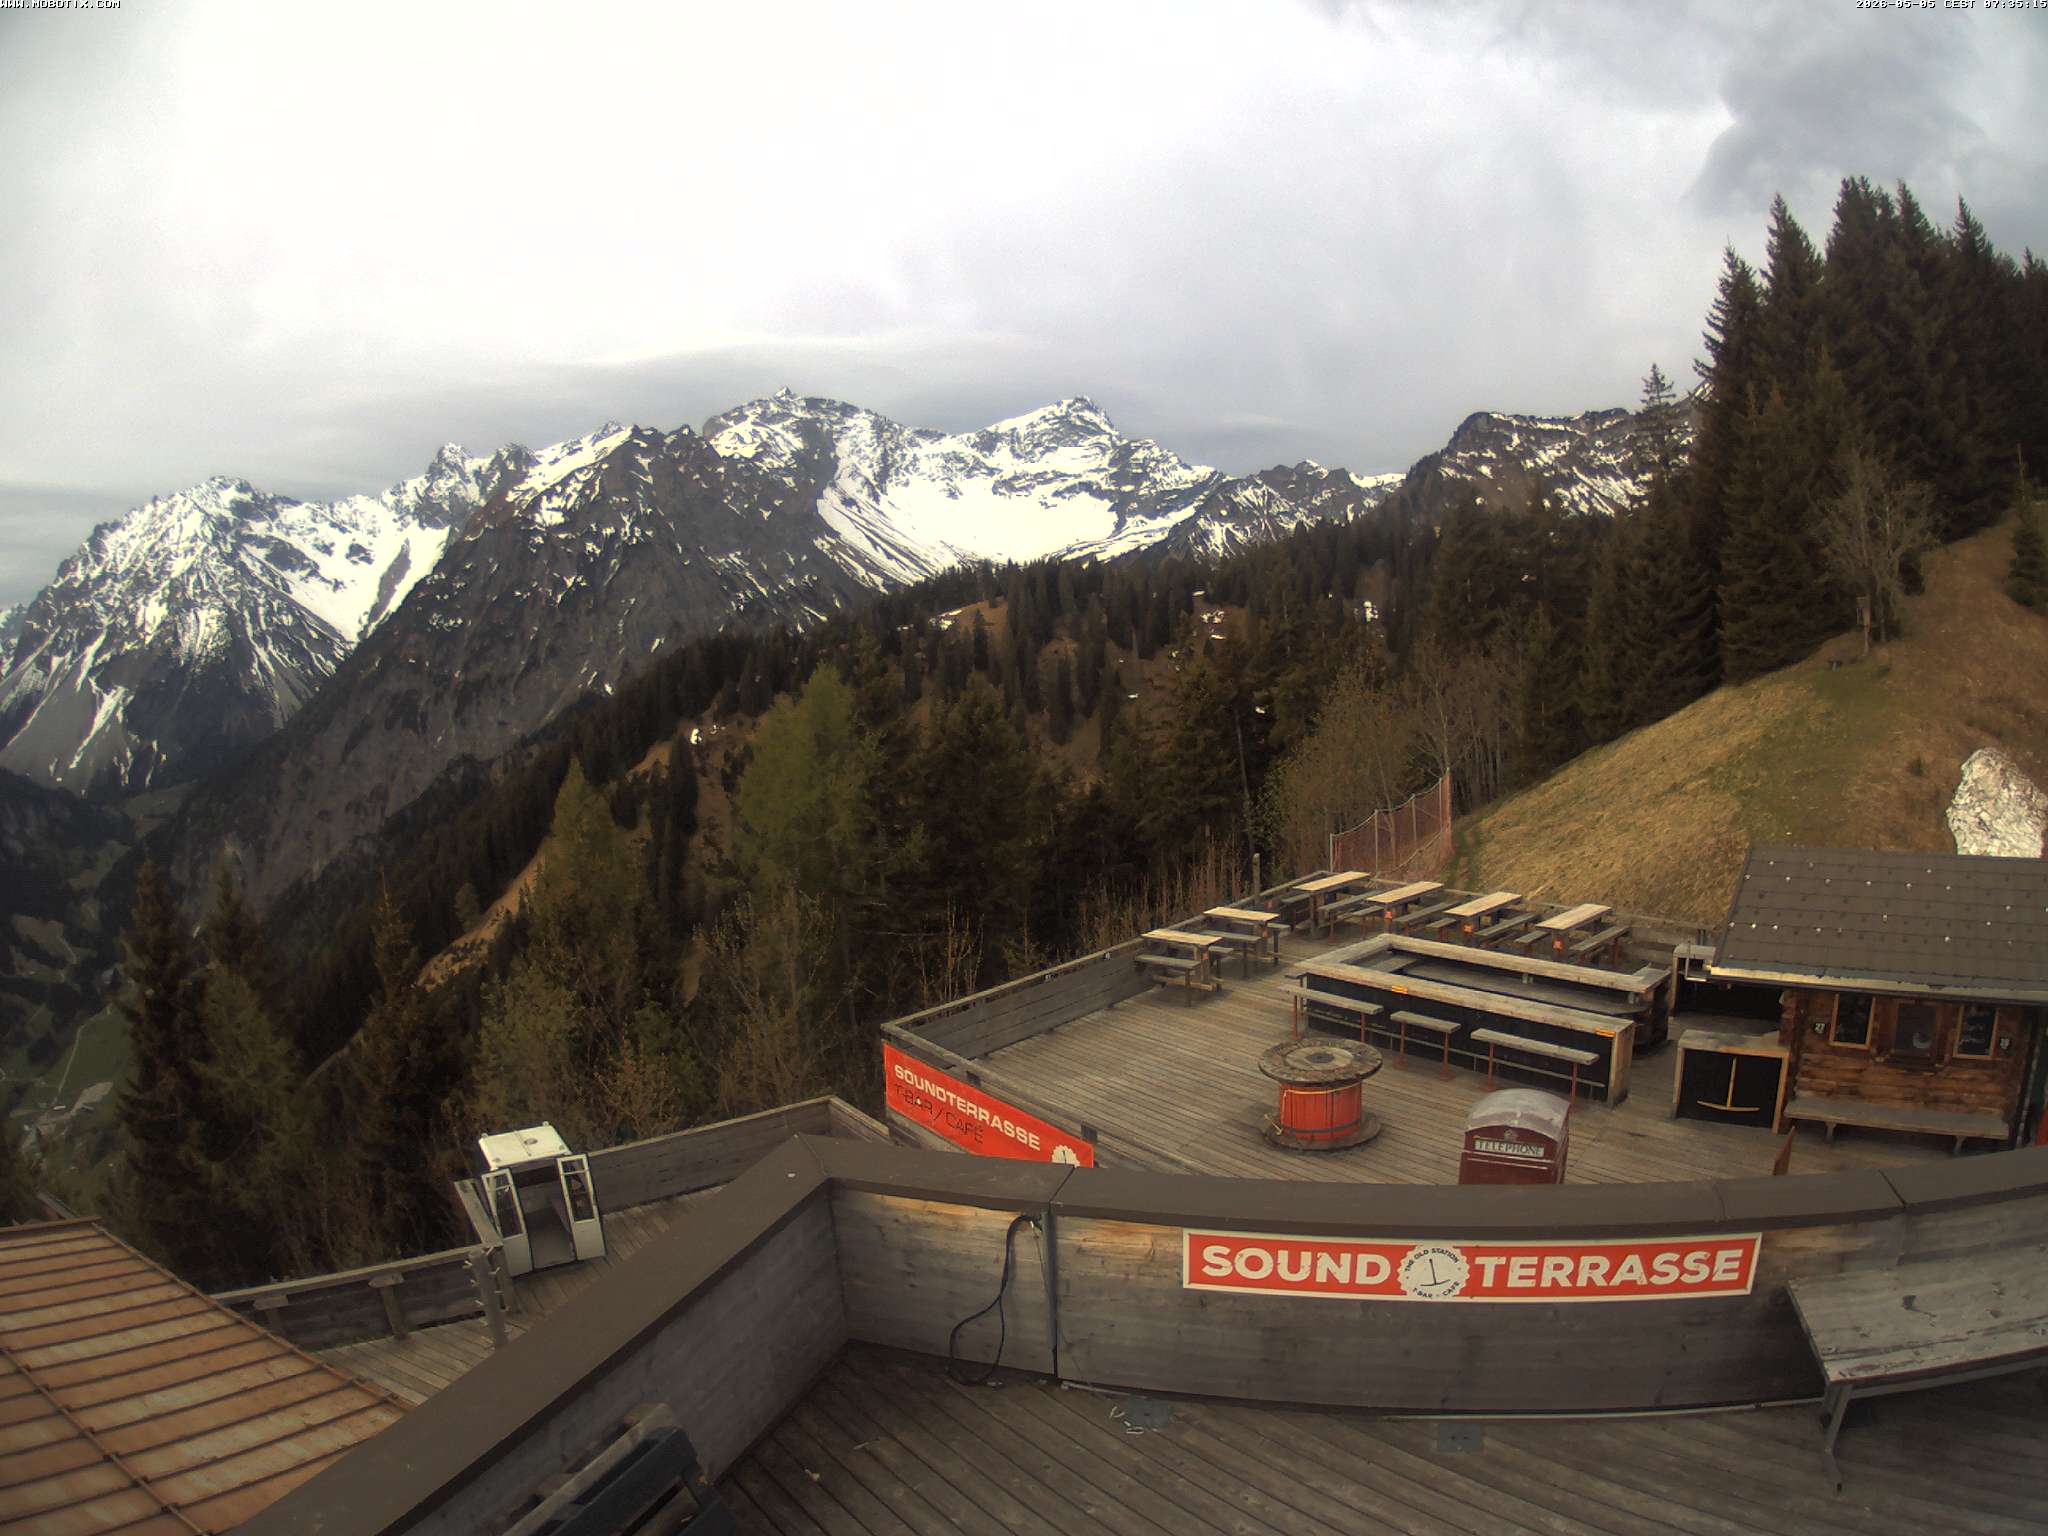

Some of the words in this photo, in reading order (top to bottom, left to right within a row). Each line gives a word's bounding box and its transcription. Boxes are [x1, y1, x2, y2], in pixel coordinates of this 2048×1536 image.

[893, 1064, 1042, 1151] SOUNDTERRASSE
[1478, 1140, 1542, 1156] TELEPHONE
[1201, 1244, 1391, 1286] SOUND
[1467, 1248, 1743, 1288] TERRASSE
[1414, 1249, 1429, 1260] OLD
[1431, 1247, 1460, 1264] STATION
